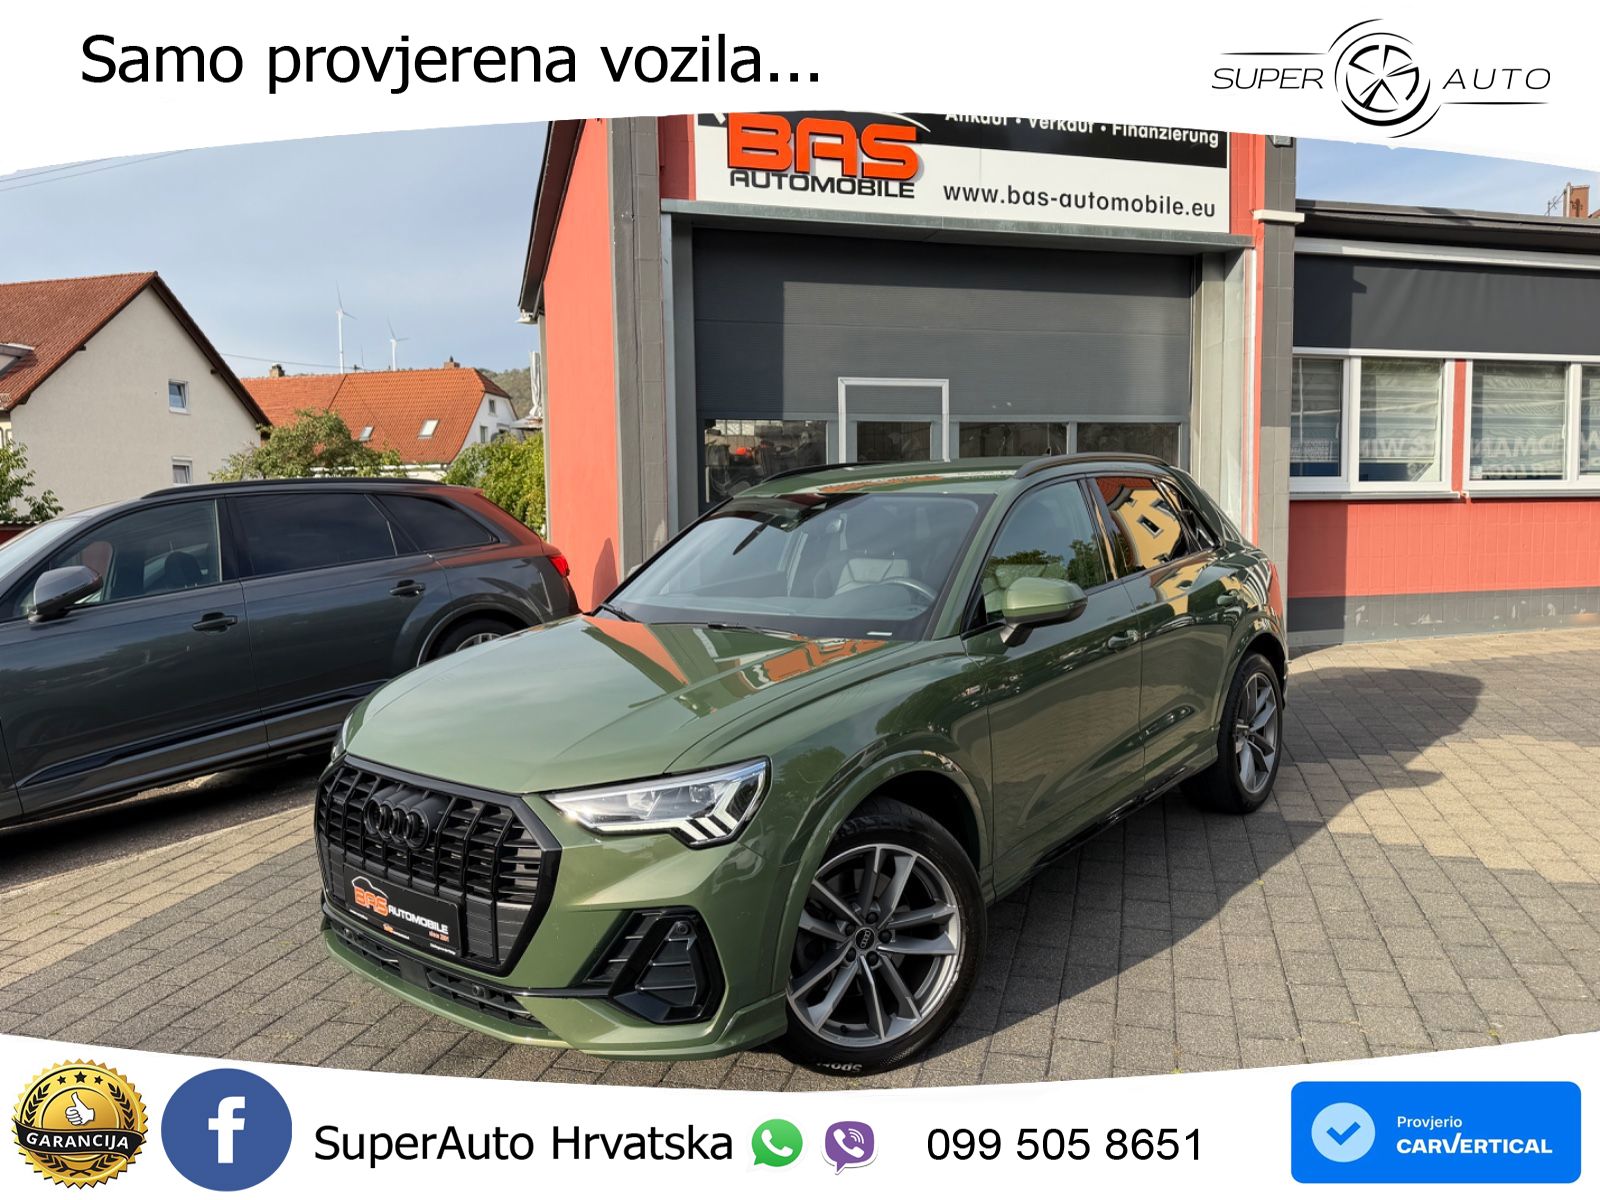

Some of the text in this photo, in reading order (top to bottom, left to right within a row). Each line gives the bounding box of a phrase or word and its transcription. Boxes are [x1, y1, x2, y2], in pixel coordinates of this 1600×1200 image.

[727, 112, 919, 181] BAS
[1112, 123, 1219, 149] Finanzierung
[729, 169, 916, 199] AUTOMOBILE
[943, 181, 1216, 218] www.bas-automobile.eu
[353, 886, 389, 917] BAS
[388, 904, 449, 935] AUTOMOBILE
